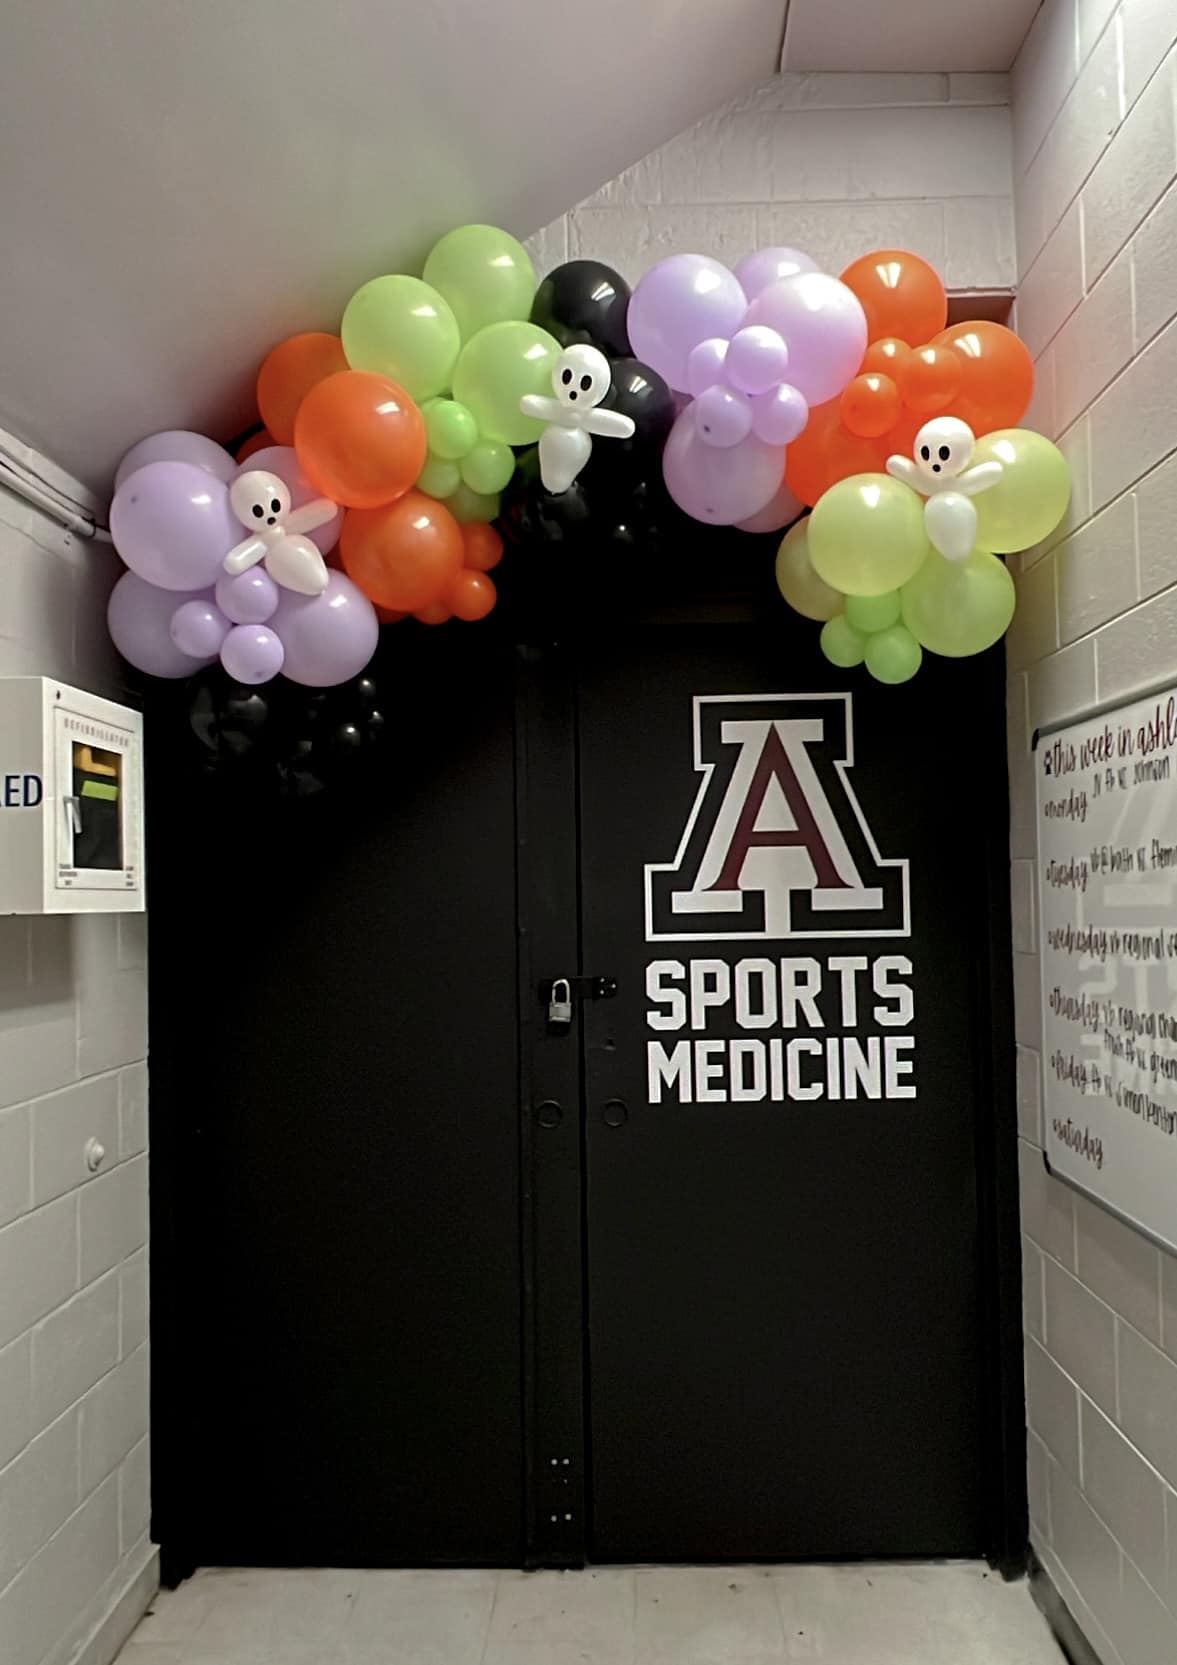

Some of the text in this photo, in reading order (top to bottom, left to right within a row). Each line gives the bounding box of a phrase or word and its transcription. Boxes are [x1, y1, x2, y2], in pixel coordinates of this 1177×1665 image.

[1054, 696, 1177, 778] this week in ashl
[0, 775, 43, 807] ED
[644, 692, 911, 942] A
[1049, 788, 1088, 823] monday
[646, 955, 914, 1031] SPORTS
[647, 1036, 917, 1104] MEDICINE
